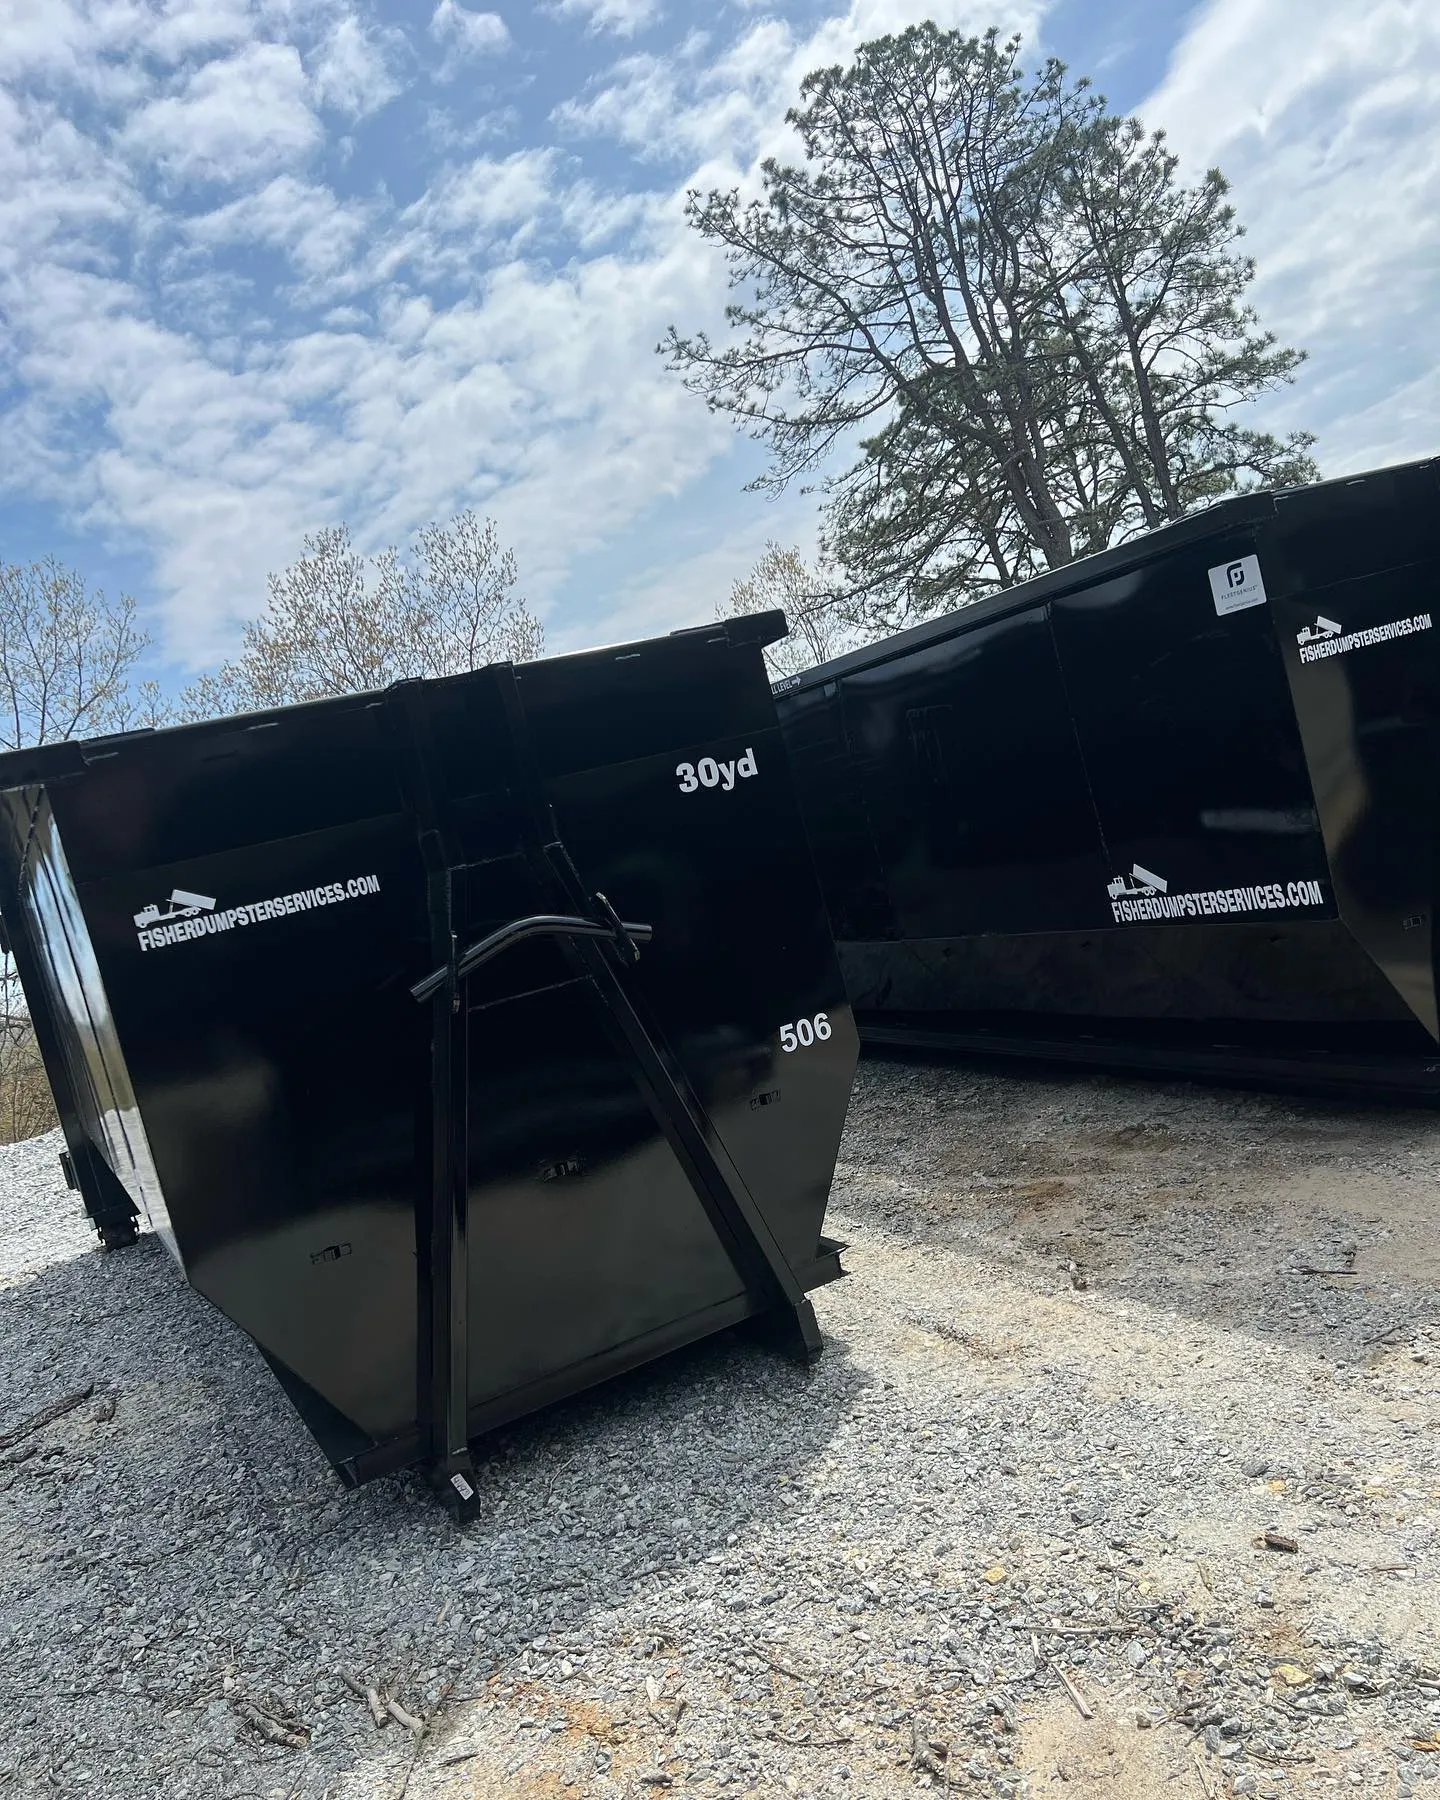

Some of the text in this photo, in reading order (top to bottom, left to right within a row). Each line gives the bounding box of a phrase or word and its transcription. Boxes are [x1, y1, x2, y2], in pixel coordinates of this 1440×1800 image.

[1299, 613, 1433, 664] FISHERDUMPSTERSERVICES.COM
[777, 680, 792, 692] LEVEL
[675, 747, 759, 793] 30yd
[137, 874, 381, 952] FISHERDUMPSTERSERVICES.COM
[1111, 880, 1324, 923] FISHERDUMPSTERSERVICES.COM
[779, 1012, 832, 1053] 506
